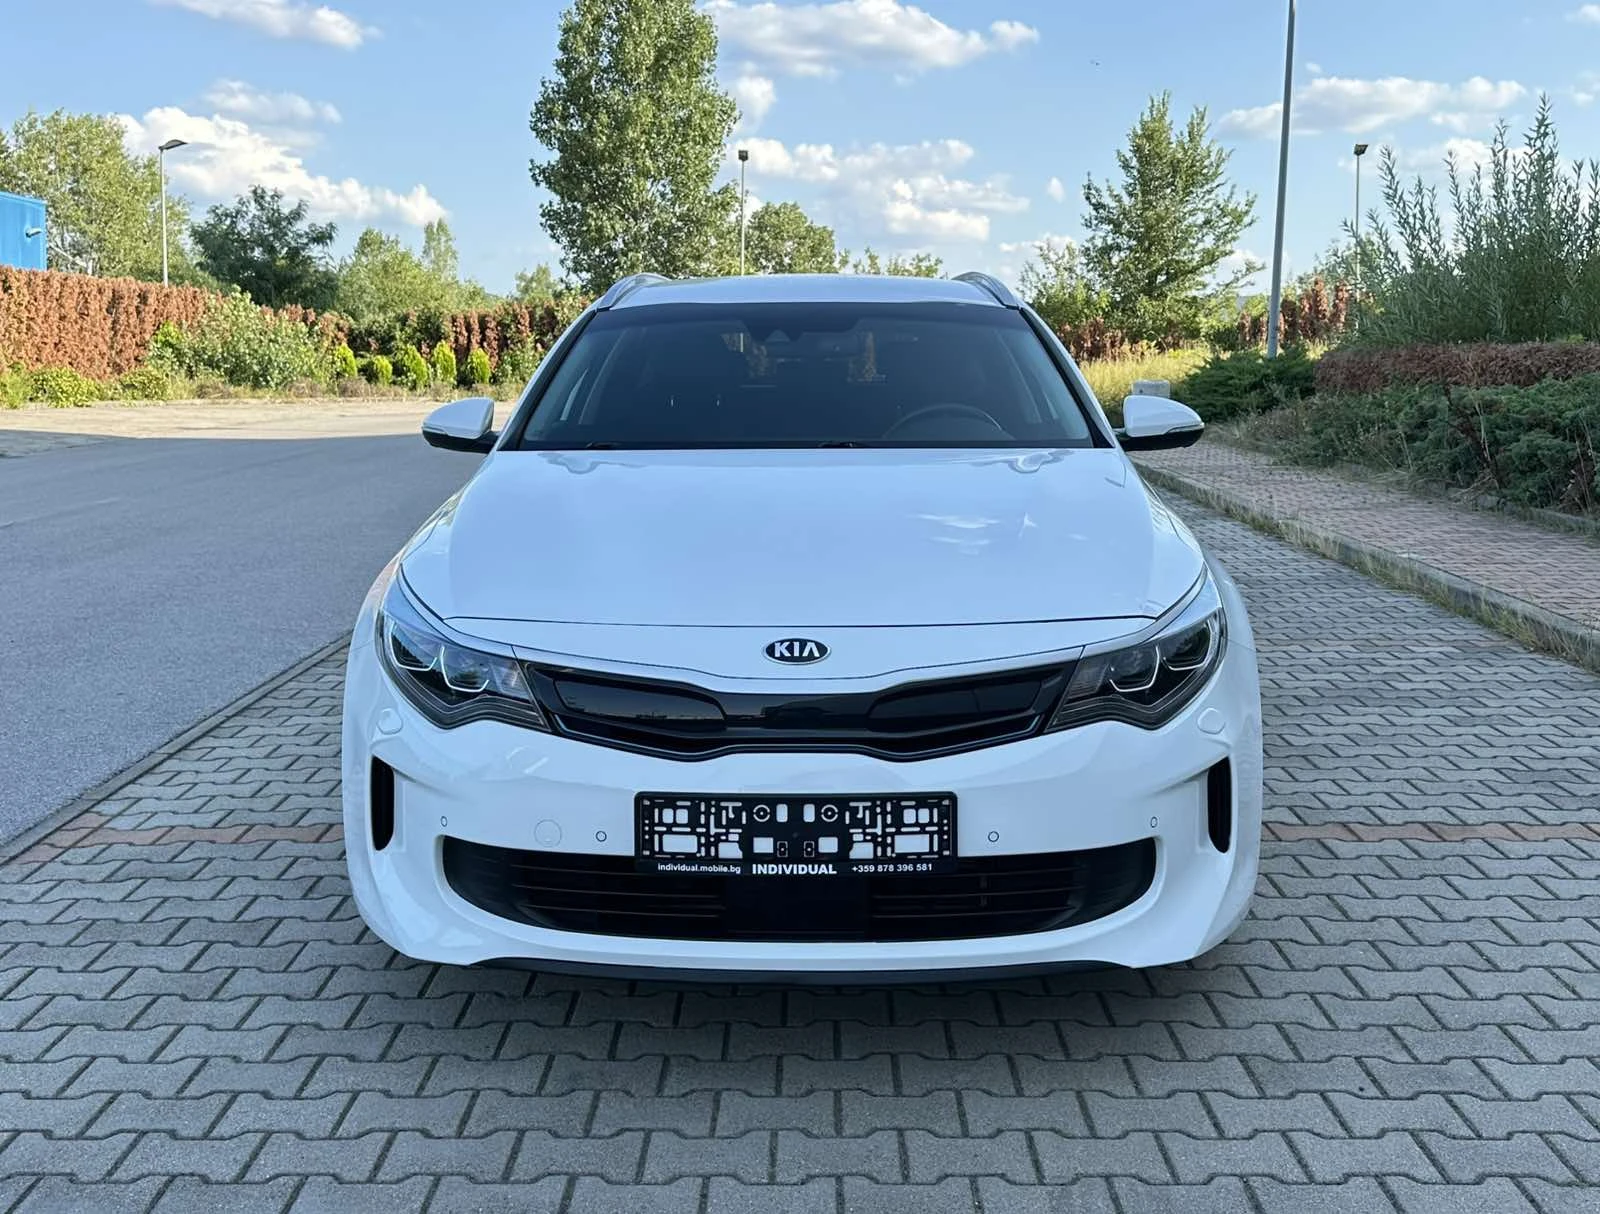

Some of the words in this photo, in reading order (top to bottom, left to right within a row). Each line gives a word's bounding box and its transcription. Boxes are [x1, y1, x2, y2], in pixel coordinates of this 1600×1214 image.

[774, 641, 820, 658] KIA
[657, 863, 741, 875] individual.mobile.bg
[752, 863, 838, 875] INDIVIDUAL
[852, 864, 875, 873] +359
[877, 864, 895, 872] 878
[897, 863, 914, 872] 396
[916, 863, 932, 871] 581
